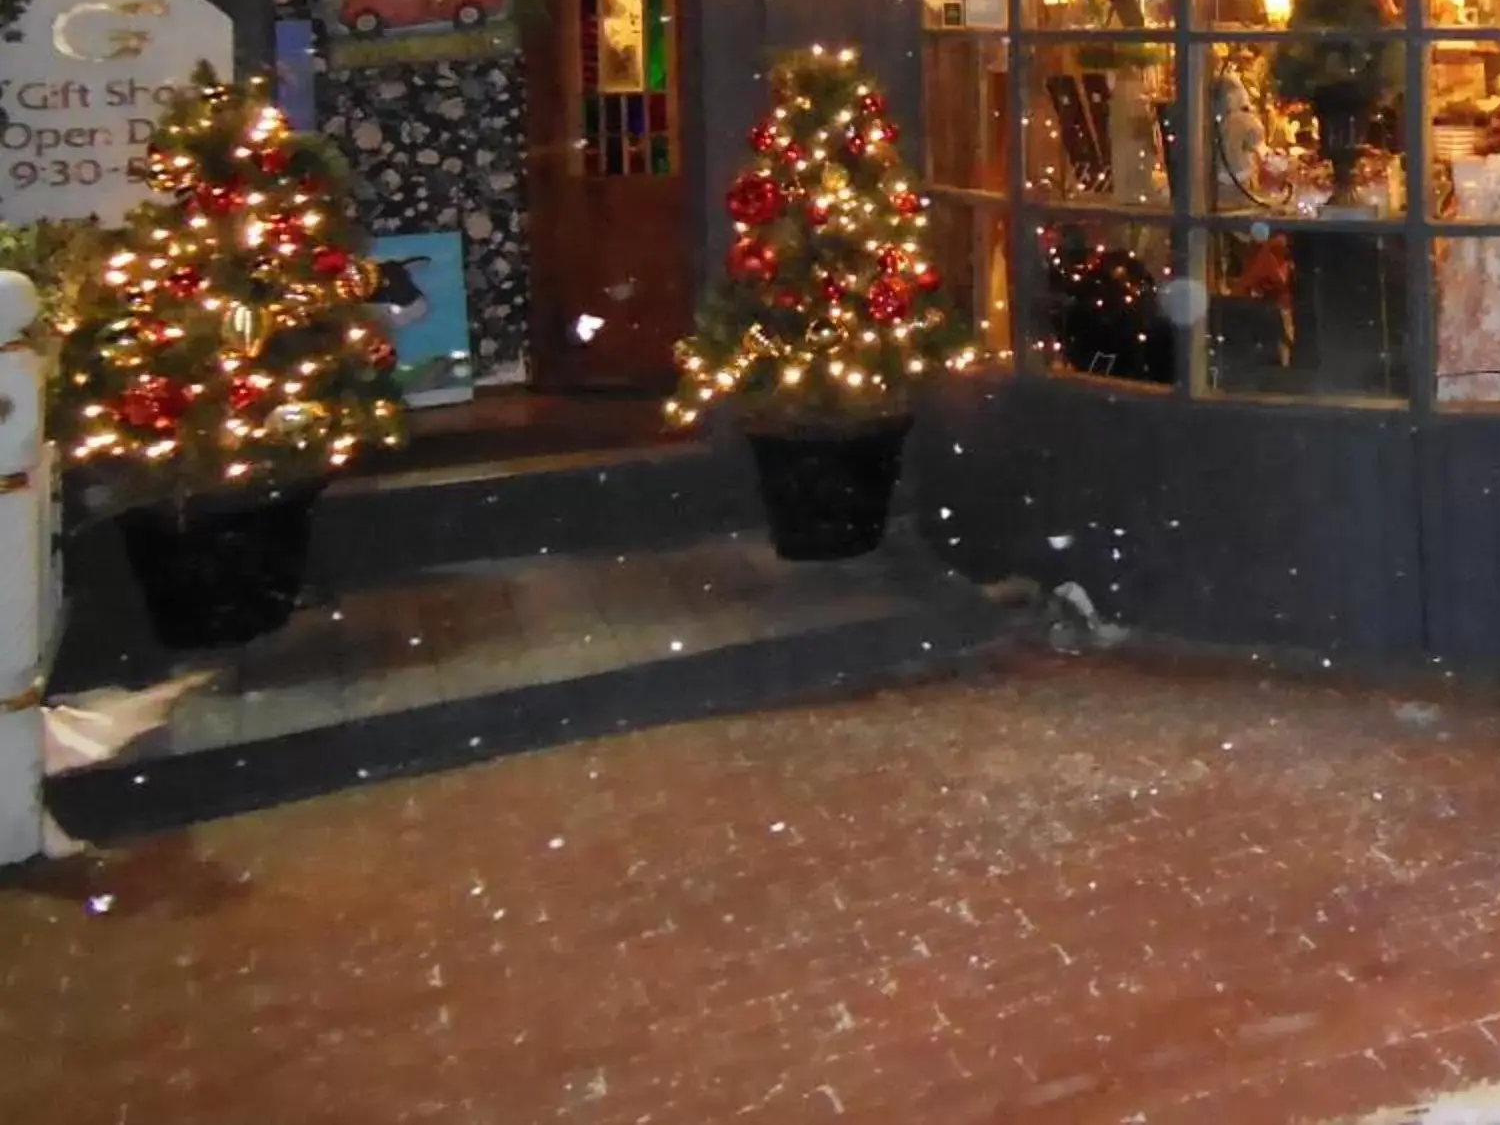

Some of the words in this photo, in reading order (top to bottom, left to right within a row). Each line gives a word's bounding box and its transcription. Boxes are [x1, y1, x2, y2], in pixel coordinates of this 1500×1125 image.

[17, 80, 90, 110] Gift
[0, 121, 113, 156] Open
[127, 118, 156, 145] D
